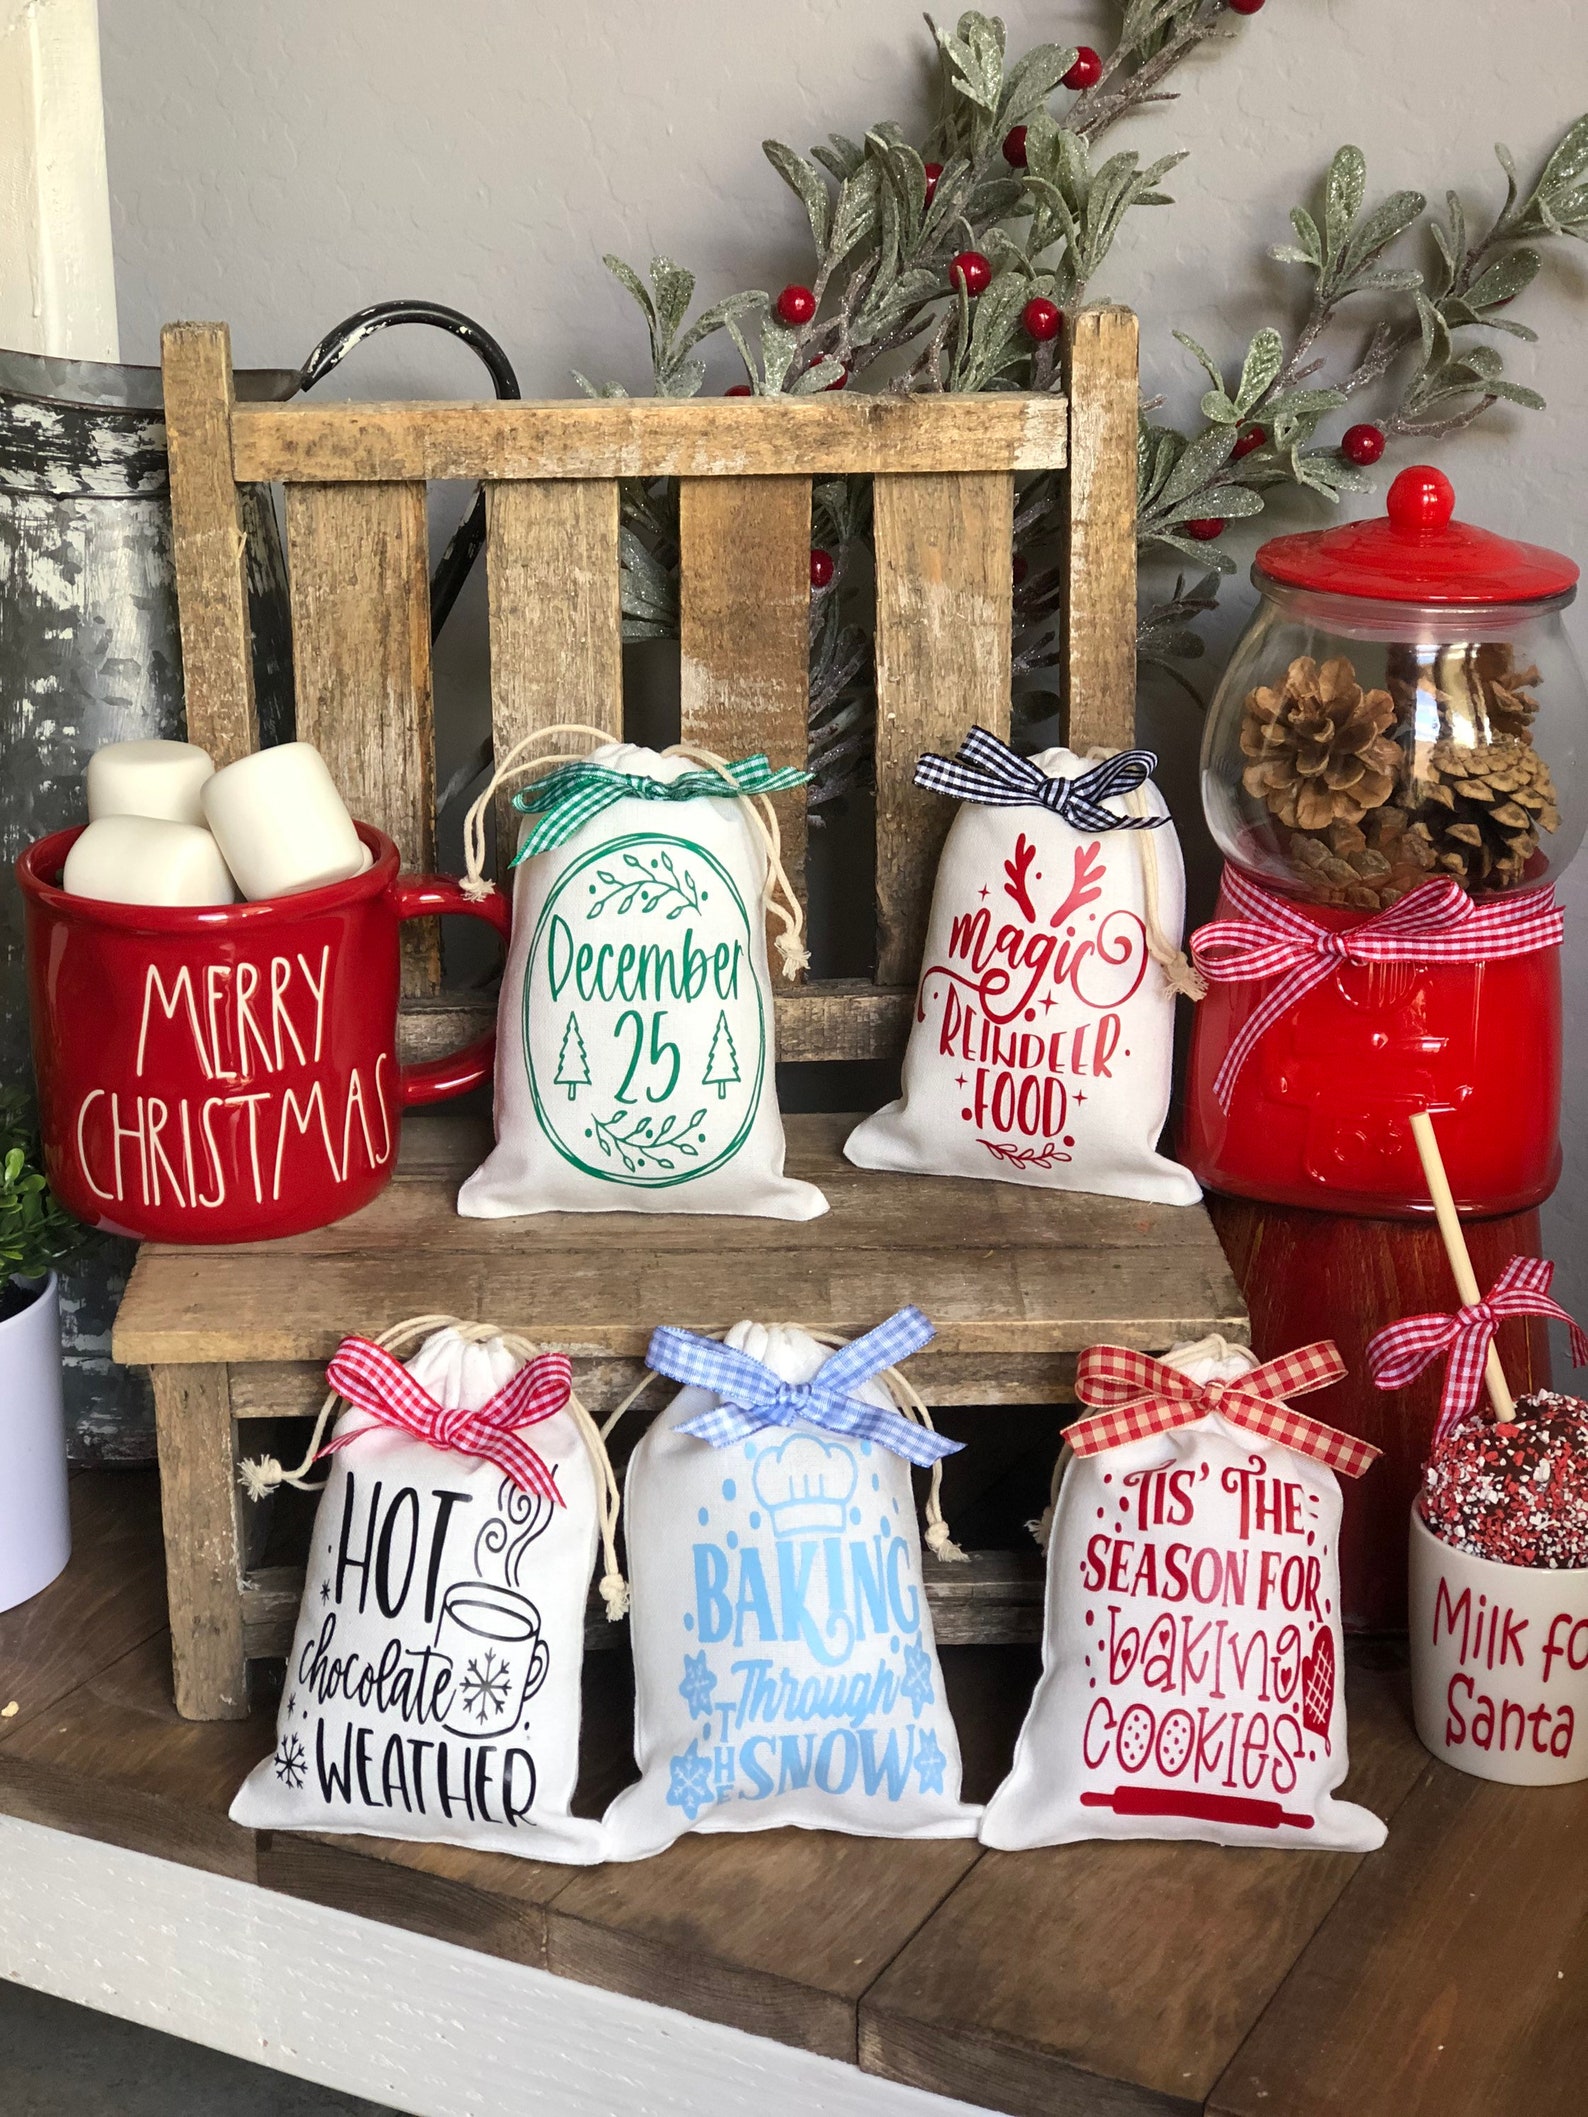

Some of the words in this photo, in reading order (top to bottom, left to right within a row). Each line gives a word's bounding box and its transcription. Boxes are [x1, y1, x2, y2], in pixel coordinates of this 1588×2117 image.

[548, 914, 744, 1002] December
[137, 945, 330, 1079] MERRY
[614, 1009, 681, 1104] 25
[940, 982, 1123, 1078] REINDEER
[77, 1053, 391, 1208] CHRISTMAS
[974, 1067, 1068, 1138] FOOD
[1221, 1454, 1306, 1540] THE
[335, 1471, 473, 1623] HOT
[1083, 1533, 1249, 1607] SEASON
[1258, 1550, 1324, 1622] FOR
[693, 1534, 921, 1667] BAKING
[1433, 1576, 1529, 1670] Milk
[298, 1612, 458, 1726] chocolate
[731, 1658, 899, 1730] Through
[1445, 1672, 1574, 1759] Santa
[316, 1718, 537, 1828] WEATHER
[738, 1723, 916, 1803] SNOW
